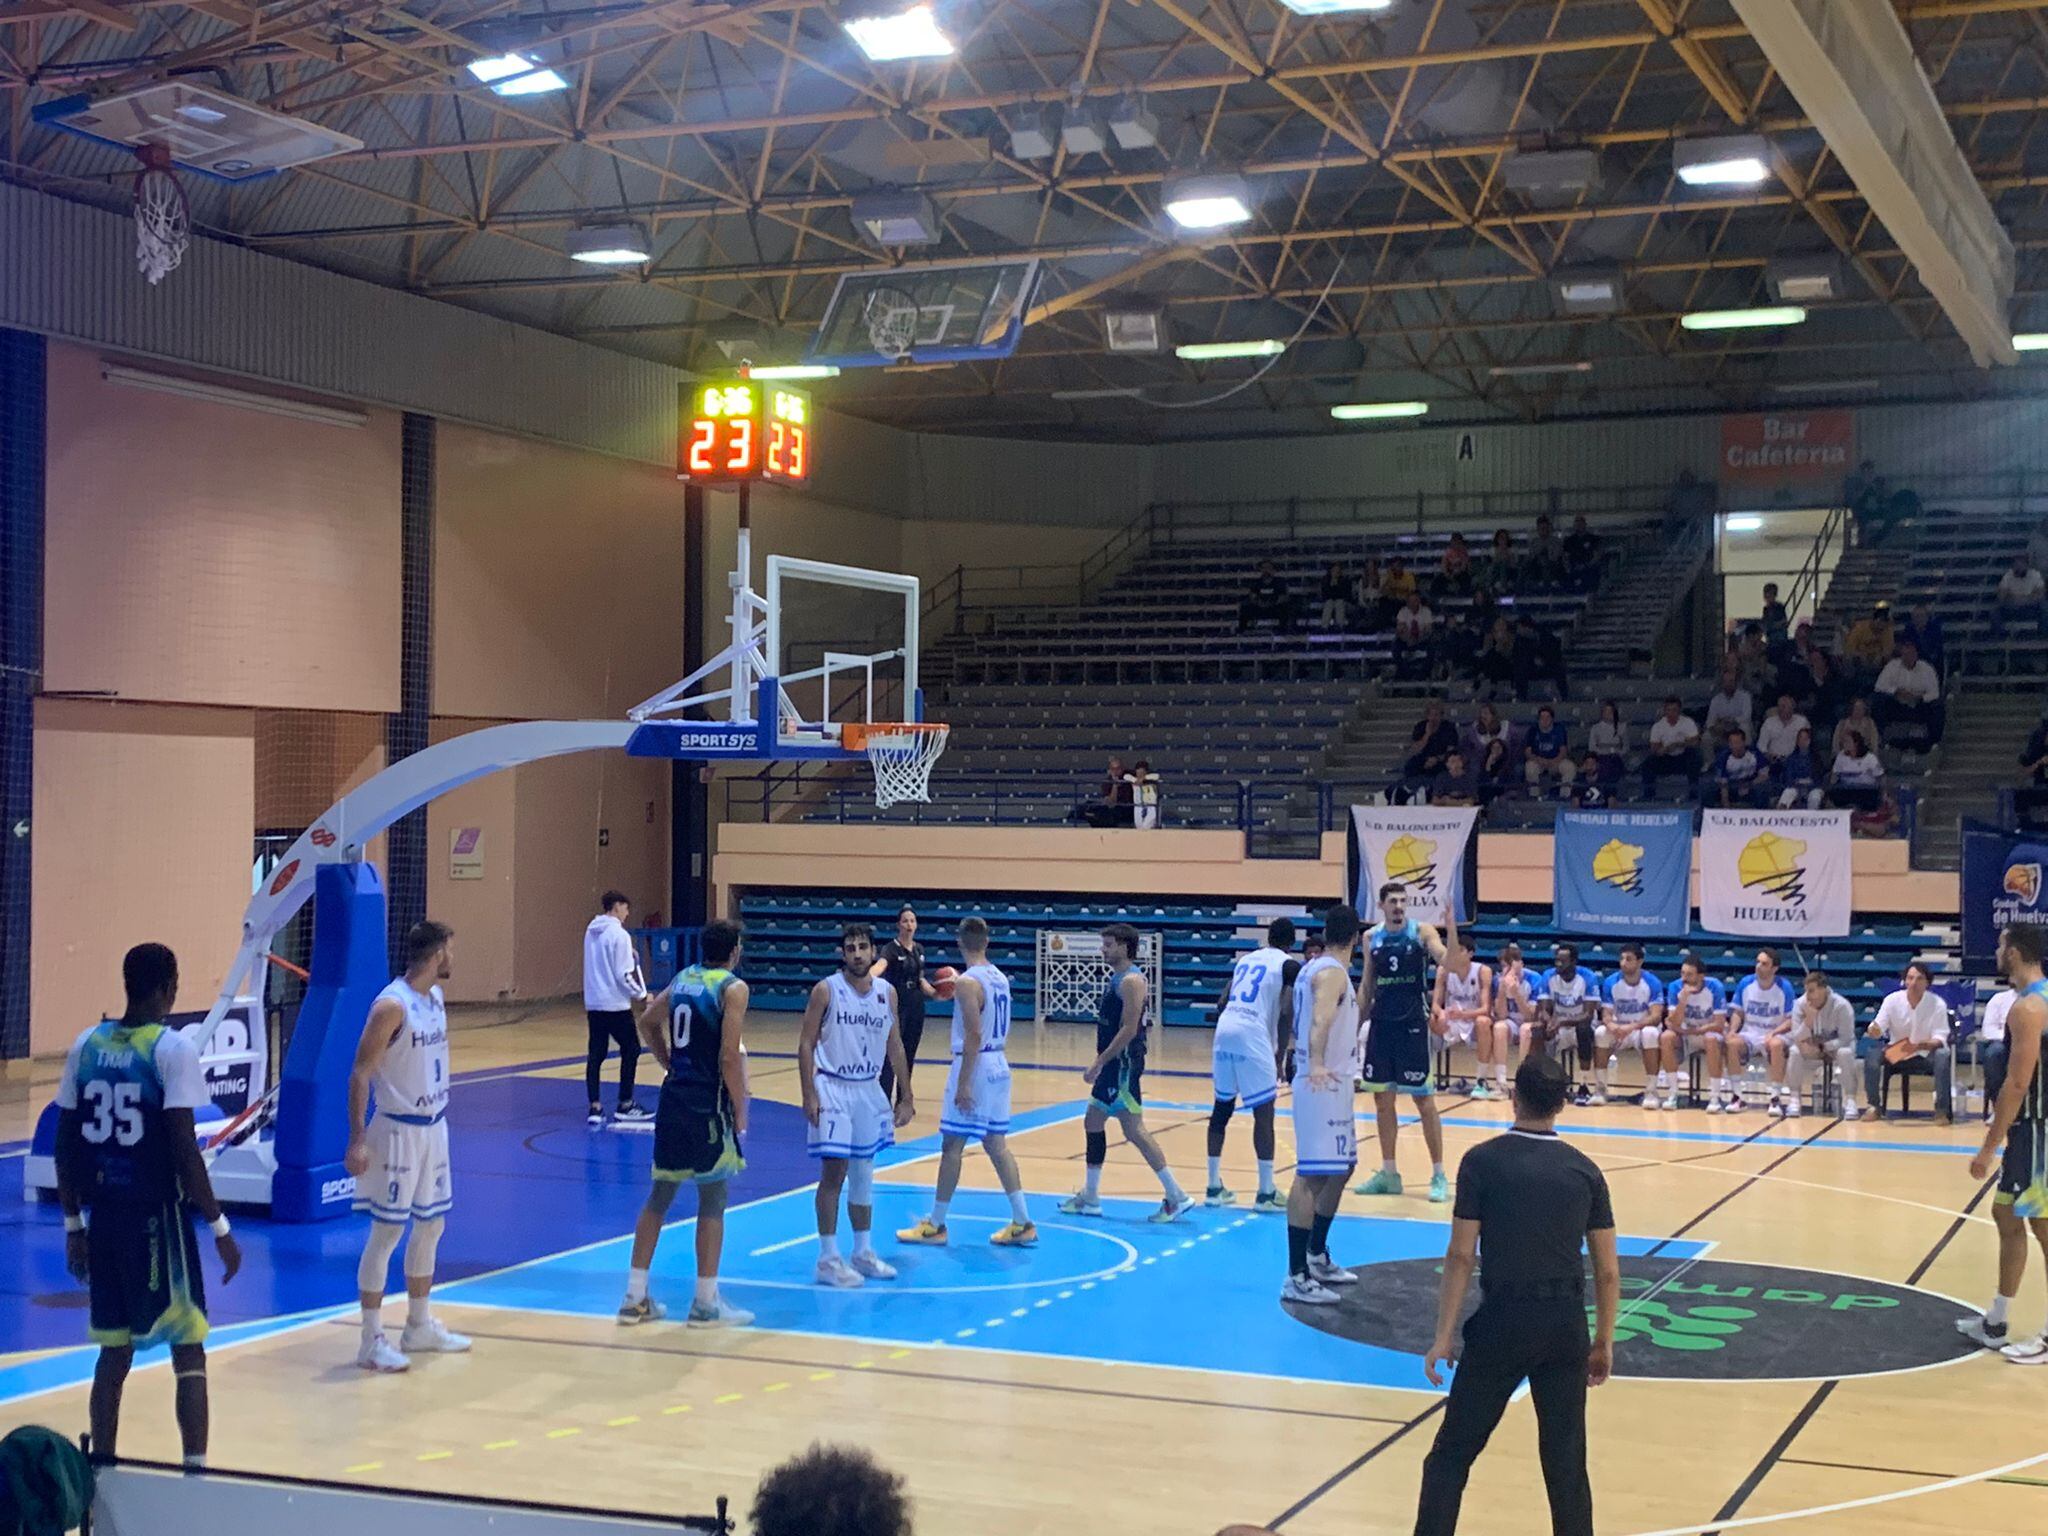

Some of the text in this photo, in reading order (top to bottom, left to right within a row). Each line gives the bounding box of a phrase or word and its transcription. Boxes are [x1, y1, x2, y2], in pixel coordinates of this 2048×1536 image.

[1763, 418, 1810, 440] Bar
[690, 419, 750, 469] 23
[769, 422, 803, 475] 23
[1459, 434, 1473, 460] A
[1740, 816, 1839, 827] BALONCESTO
[1734, 906, 1808, 923] HUELVA
[1993, 909, 2008, 924] de
[1389, 955, 1399, 972] 3
[1229, 963, 1267, 1003] 23
[673, 1003, 692, 1048] 0
[836, 1011, 884, 1028] Huelva
[992, 992, 1008, 1039] 10
[1366, 1063, 1374, 1079] 3
[81, 1079, 144, 1146] 35
[826, 1120, 835, 1140] 7
[1336, 1134, 1348, 1156] 12
[388, 1181, 400, 1204] 9
